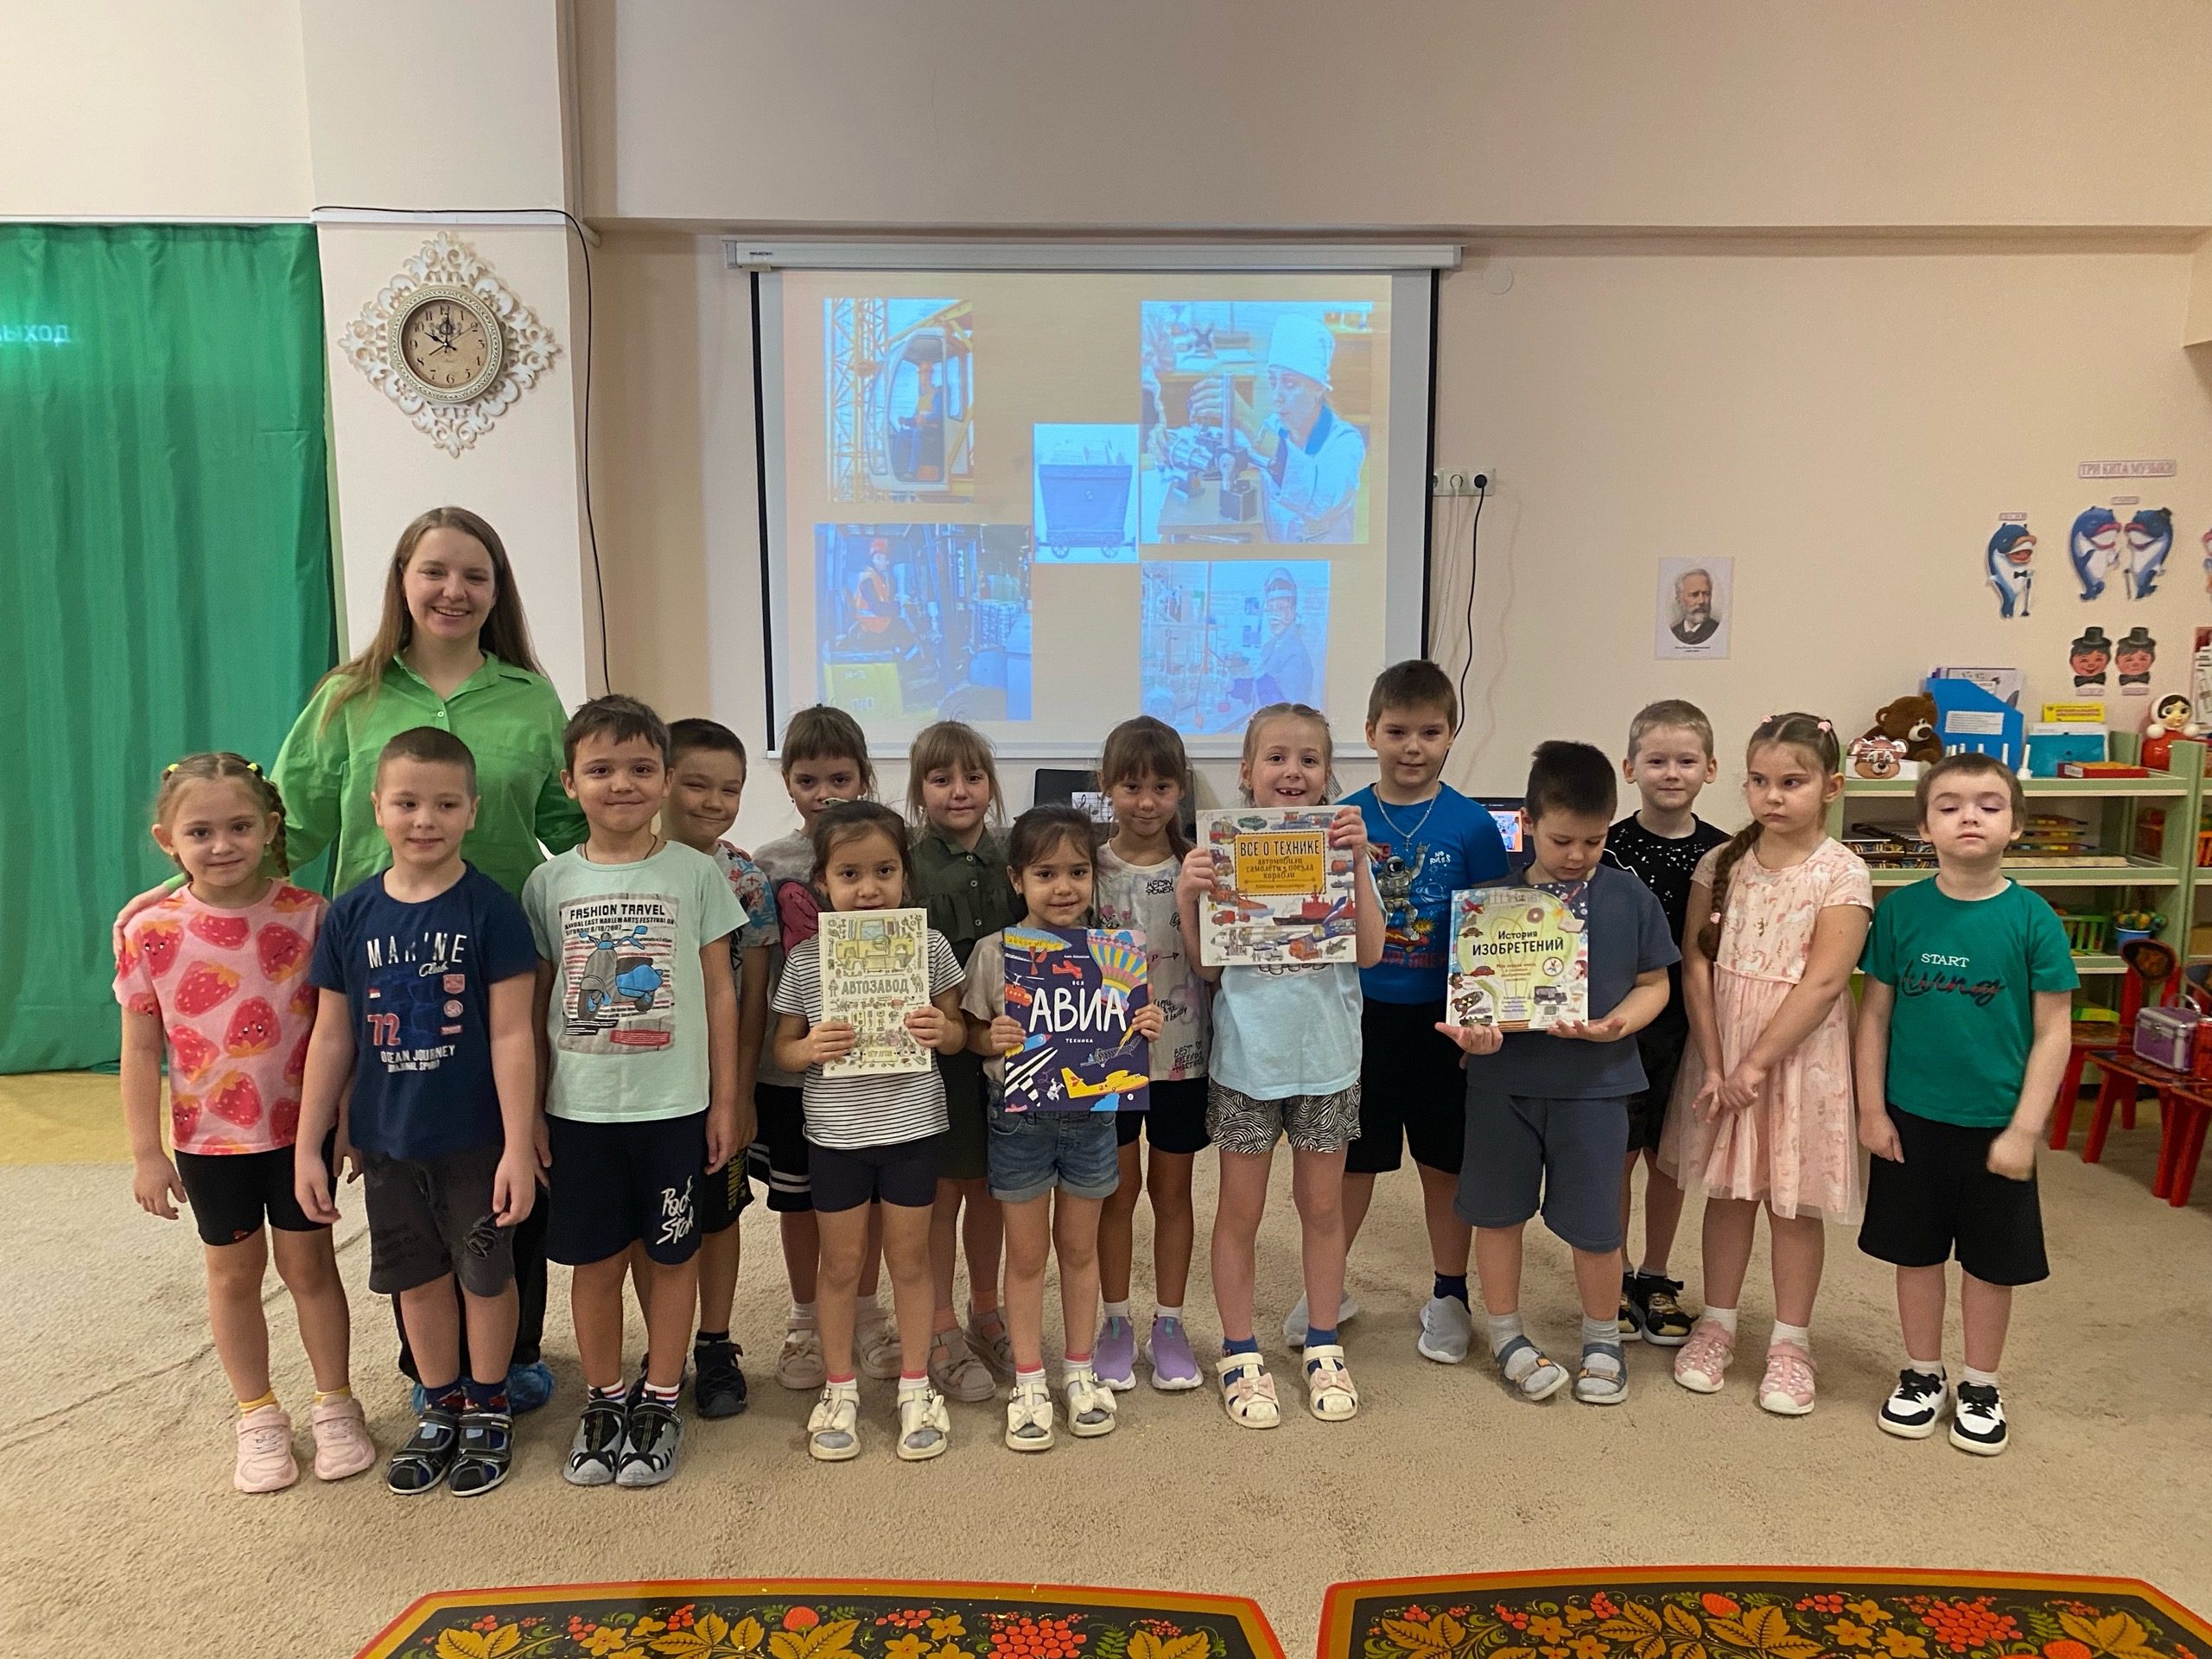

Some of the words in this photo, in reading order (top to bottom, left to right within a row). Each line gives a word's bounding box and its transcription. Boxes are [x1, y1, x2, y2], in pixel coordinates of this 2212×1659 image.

[1274, 840, 1319, 855] ТЕХНИКЕ
[570, 904, 617, 920] FASHION
[621, 904, 664, 916] TRAVEL
[1497, 931, 1538, 940] История
[1472, 937, 1564, 956] ИЗОБРЕТЕНИЙ
[1921, 953, 1970, 967] START
[842, 978, 910, 995] АВТОЗАВОД
[1028, 987, 1127, 1033] АВИА
[367, 1013, 401, 1046] 72
